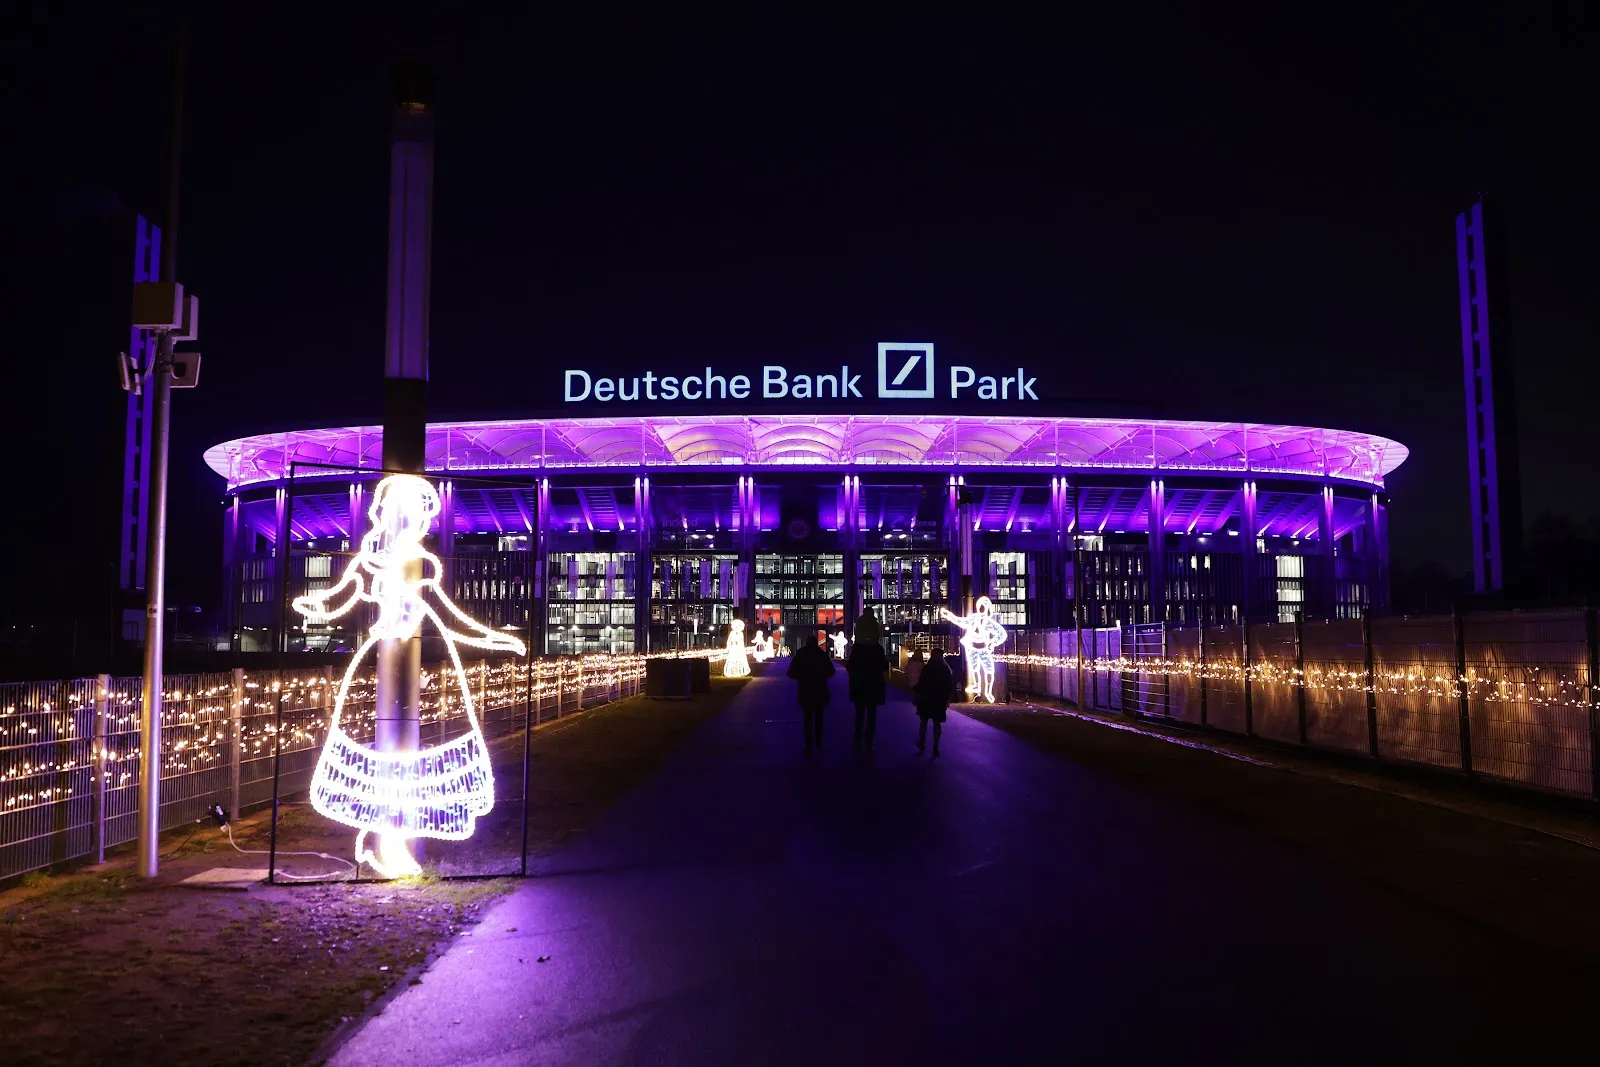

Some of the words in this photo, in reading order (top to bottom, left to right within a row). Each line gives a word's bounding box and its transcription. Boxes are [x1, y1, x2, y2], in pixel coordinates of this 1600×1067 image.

[564, 366, 751, 402] Deutsche
[763, 365, 864, 399] Bank
[950, 365, 1039, 401] Park
